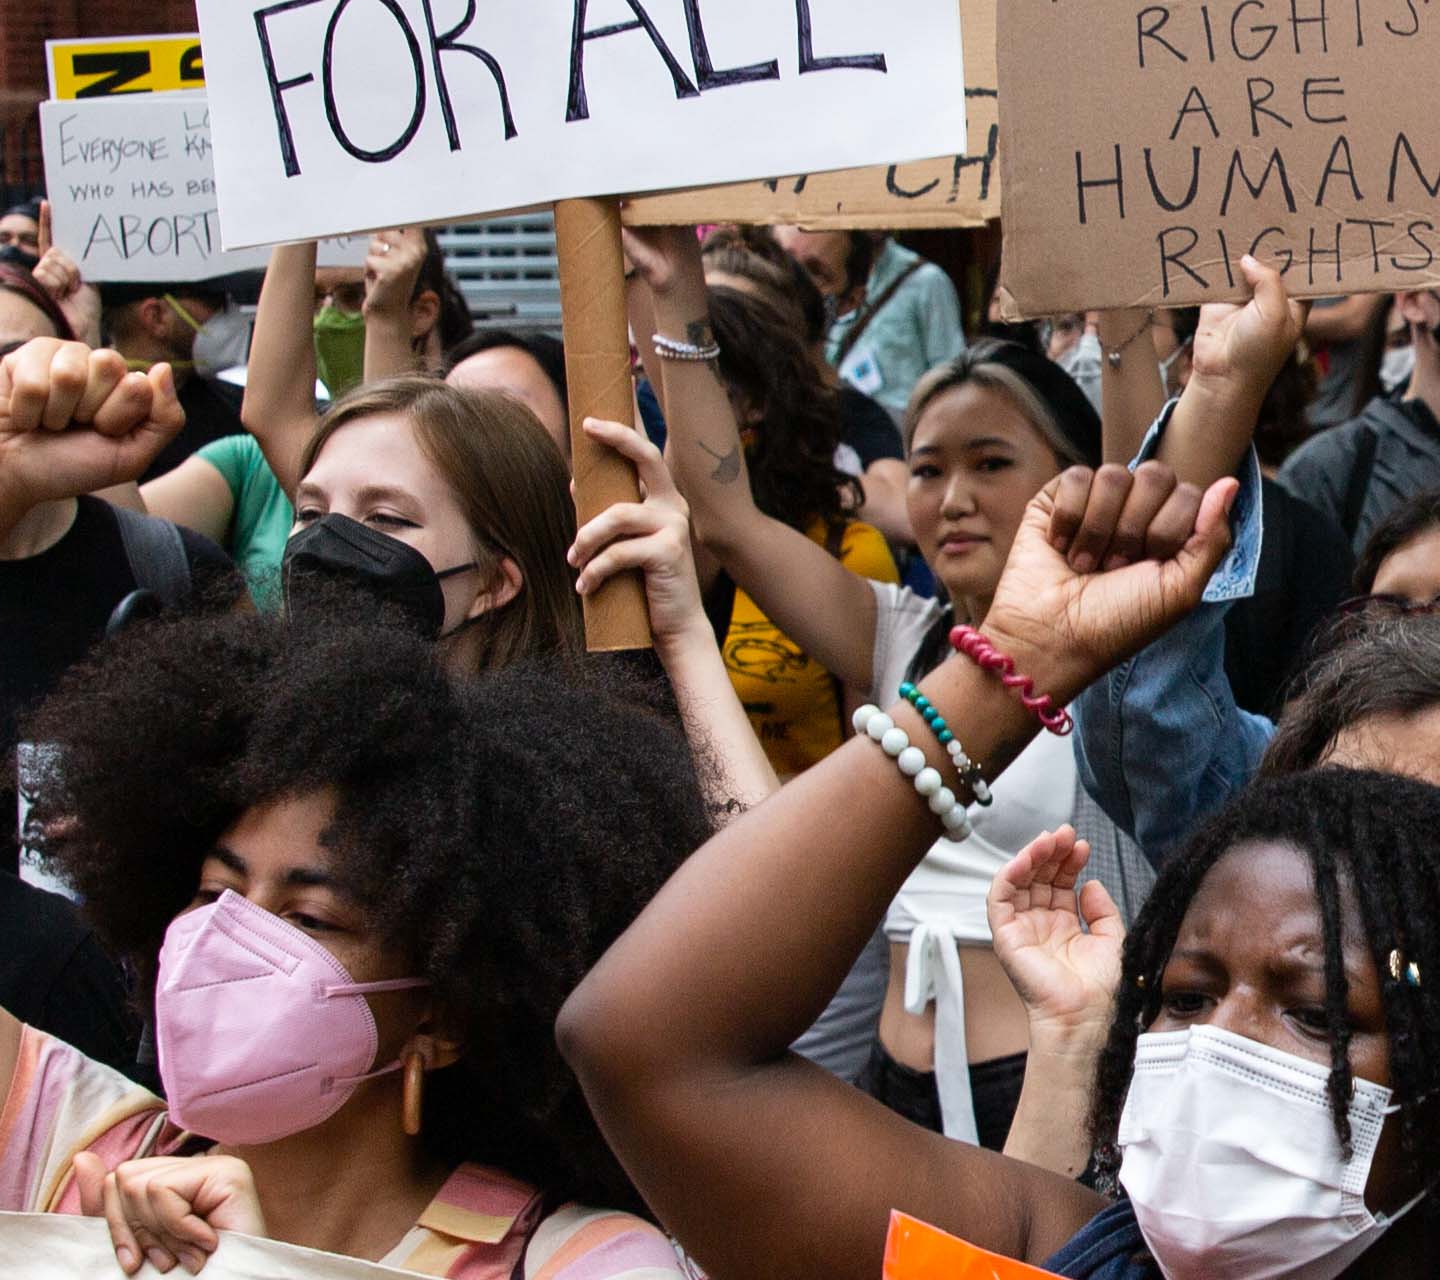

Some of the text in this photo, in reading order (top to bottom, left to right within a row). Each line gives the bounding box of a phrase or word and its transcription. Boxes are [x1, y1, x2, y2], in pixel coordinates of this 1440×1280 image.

[1169, 76, 1347, 141] ARE
[59, 114, 170, 174] EVERYONE
[70, 182, 115, 203] WHO
[131, 179, 175, 200] HAS
[81, 206, 220, 263] ABORT
[1157, 219, 1436, 297] RIGHTS
